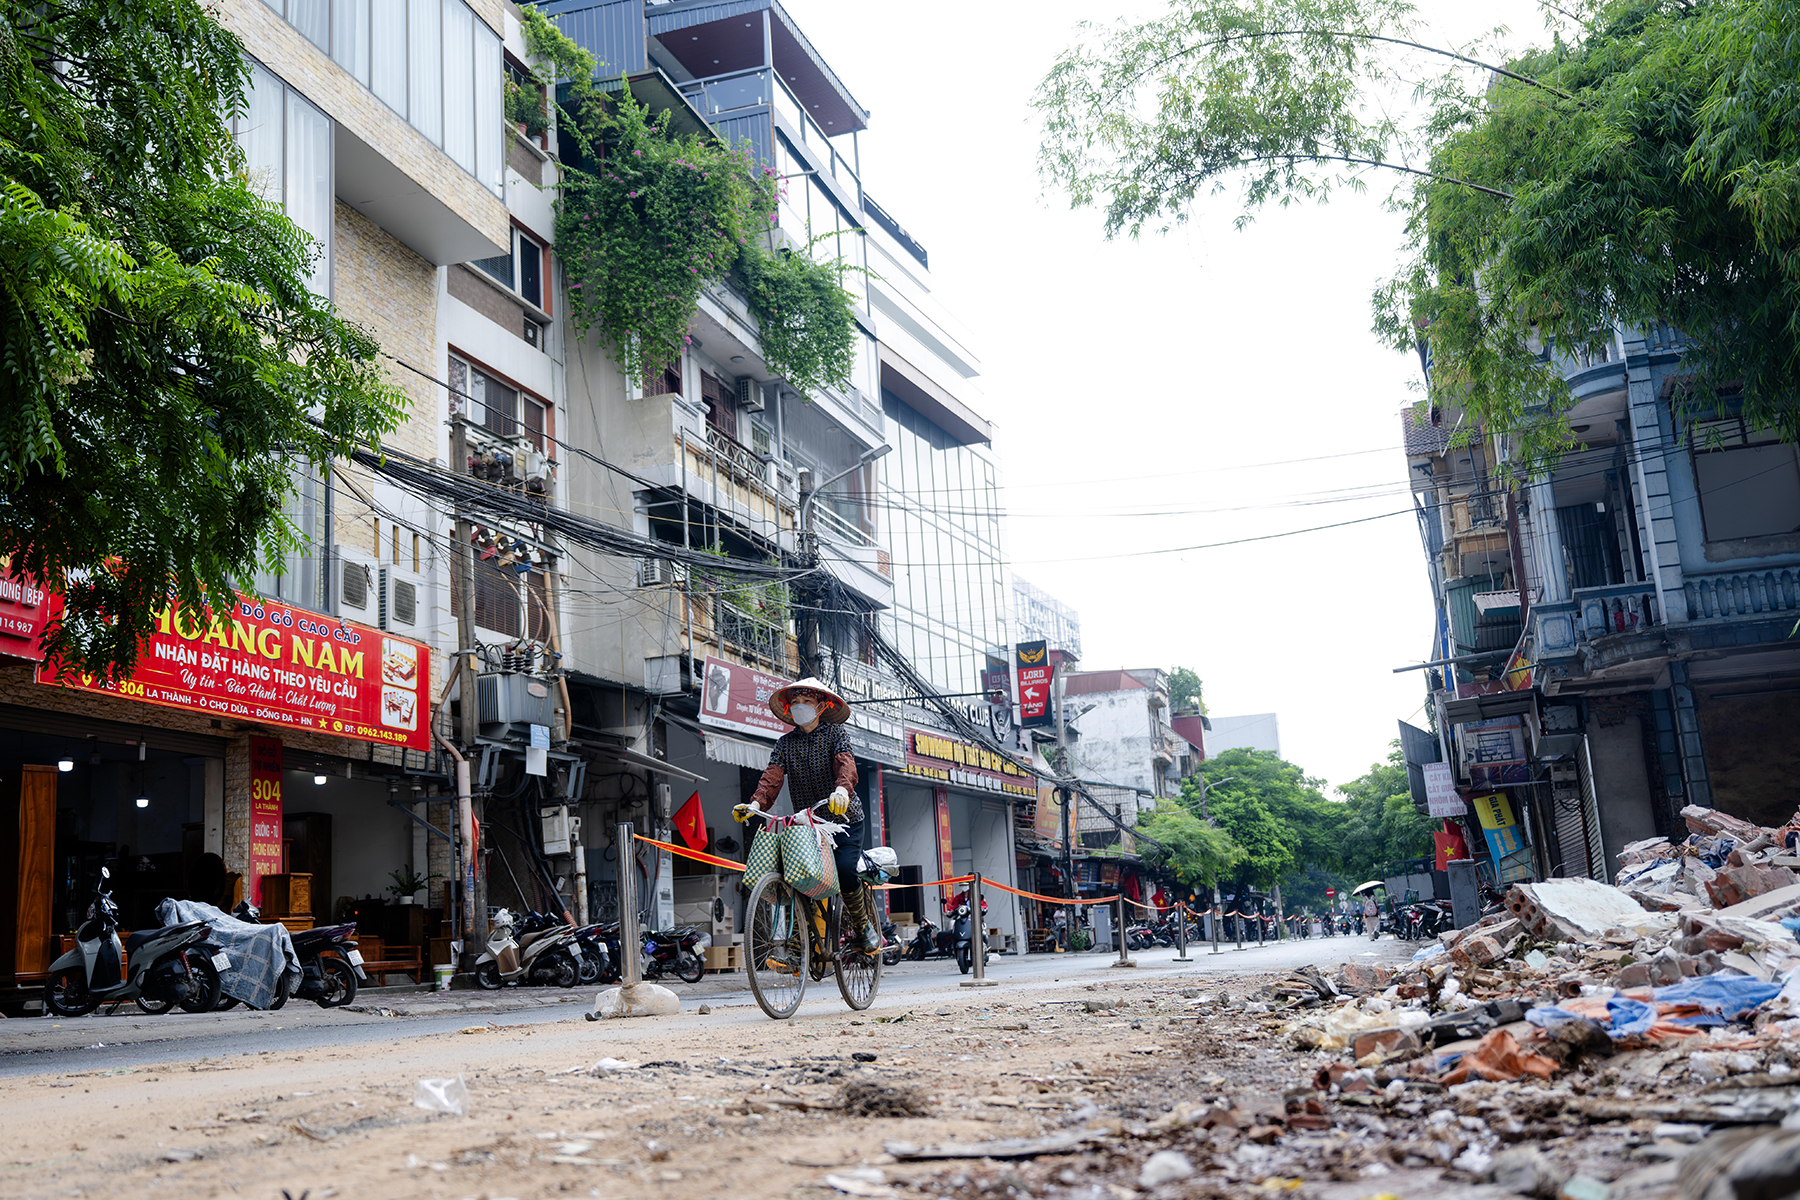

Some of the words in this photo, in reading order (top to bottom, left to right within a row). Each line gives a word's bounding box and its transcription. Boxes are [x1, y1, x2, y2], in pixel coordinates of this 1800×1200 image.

[17, 621, 33, 634] 987
[270, 608, 294, 628] GỖ
[298, 619, 329, 637] CAO
[333, 627, 361, 646] CẤP
[291, 634, 365, 680] NAM
[155, 642, 198, 667] NHẬN
[201, 652, 230, 674] ĐẶT
[232, 658, 270, 681] HÀNG
[273, 669, 306, 688] THEO
[308, 674, 331, 694] YÊU
[333, 678, 357, 699] CẦU
[1023, 669, 1045, 680] LORD
[180, 668, 197, 690] Uy
[199, 674, 216, 689] tín
[225, 678, 247, 695] Bảo
[247, 683, 277, 701] Hành
[285, 690, 308, 706] Chất
[309, 695, 337, 716] Lượng
[119, 681, 144, 696] 304
[146, 688, 158, 698] LA
[161, 690, 192, 704] THÀNH
[199, 697, 207, 707] Ô
[209, 701, 228, 712] CHỢ
[230, 703, 249, 715] DỪA
[256, 708, 280, 720] ĐỐNG
[282, 714, 293, 722] ĐA
[300, 717, 312, 725] HN
[344, 725, 356, 734] ĐT:
[357, 726, 408, 743] 0962.143.189
[969, 703, 991, 727] CLUB
[253, 778, 281, 801] 304
[262, 802, 279, 811] THÀNH
[1489, 796, 1500, 809] GIA
[1493, 808, 1507, 826] PHÁT
[253, 840, 267, 856] PHÒNG
[267, 841, 280, 857] KHÁCH
[256, 859, 270, 875] PHÒNG
